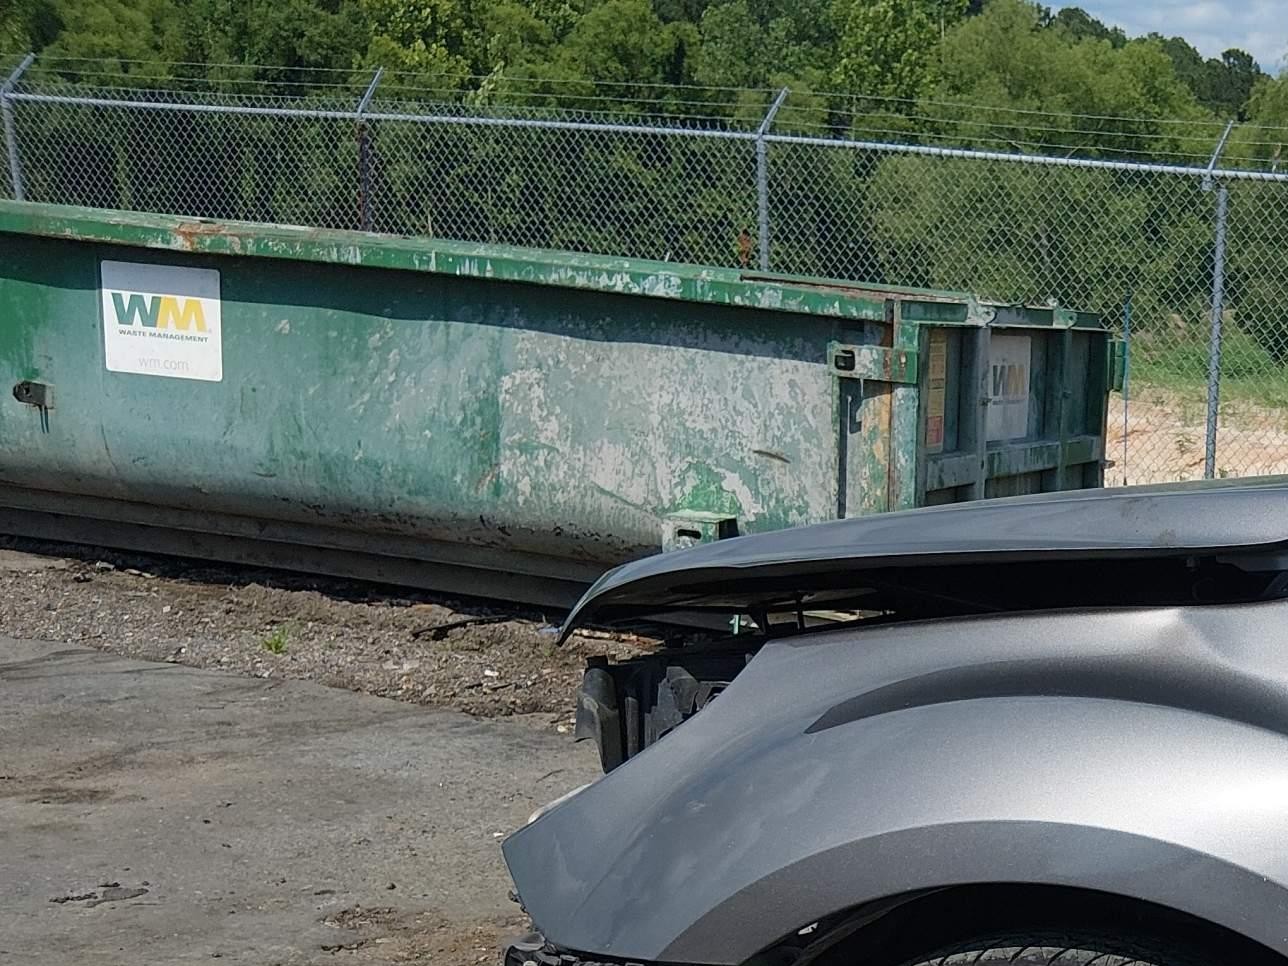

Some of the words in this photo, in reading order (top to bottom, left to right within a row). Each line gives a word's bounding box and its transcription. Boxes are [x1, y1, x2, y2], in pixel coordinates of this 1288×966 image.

[111, 292, 208, 333] WM
[118, 329, 147, 338] WASTE
[149, 332, 209, 343] MANAGEMENT
[138, 357, 190, 371] wm.com
